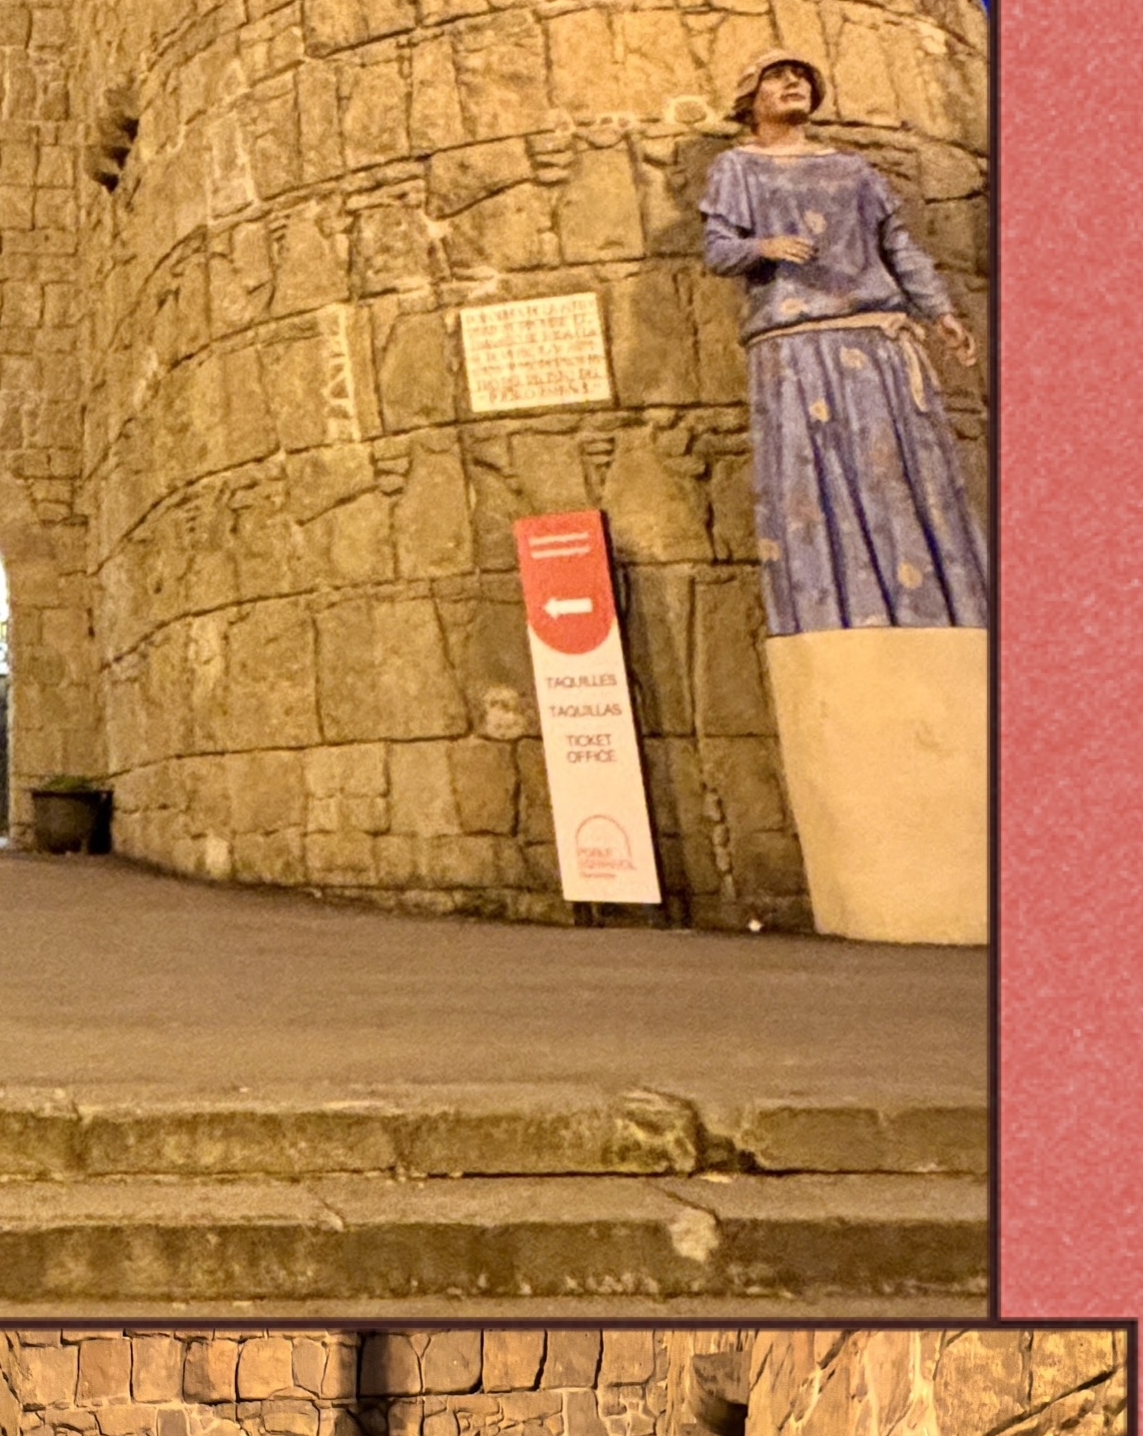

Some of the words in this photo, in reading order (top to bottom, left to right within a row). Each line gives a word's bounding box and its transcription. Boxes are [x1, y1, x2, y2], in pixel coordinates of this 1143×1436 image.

[547, 673, 618, 689] TAQUILLES
[549, 703, 623, 718] TAQUILLAS
[566, 733, 612, 747] TICKET
[567, 749, 617, 764] OFFICE
